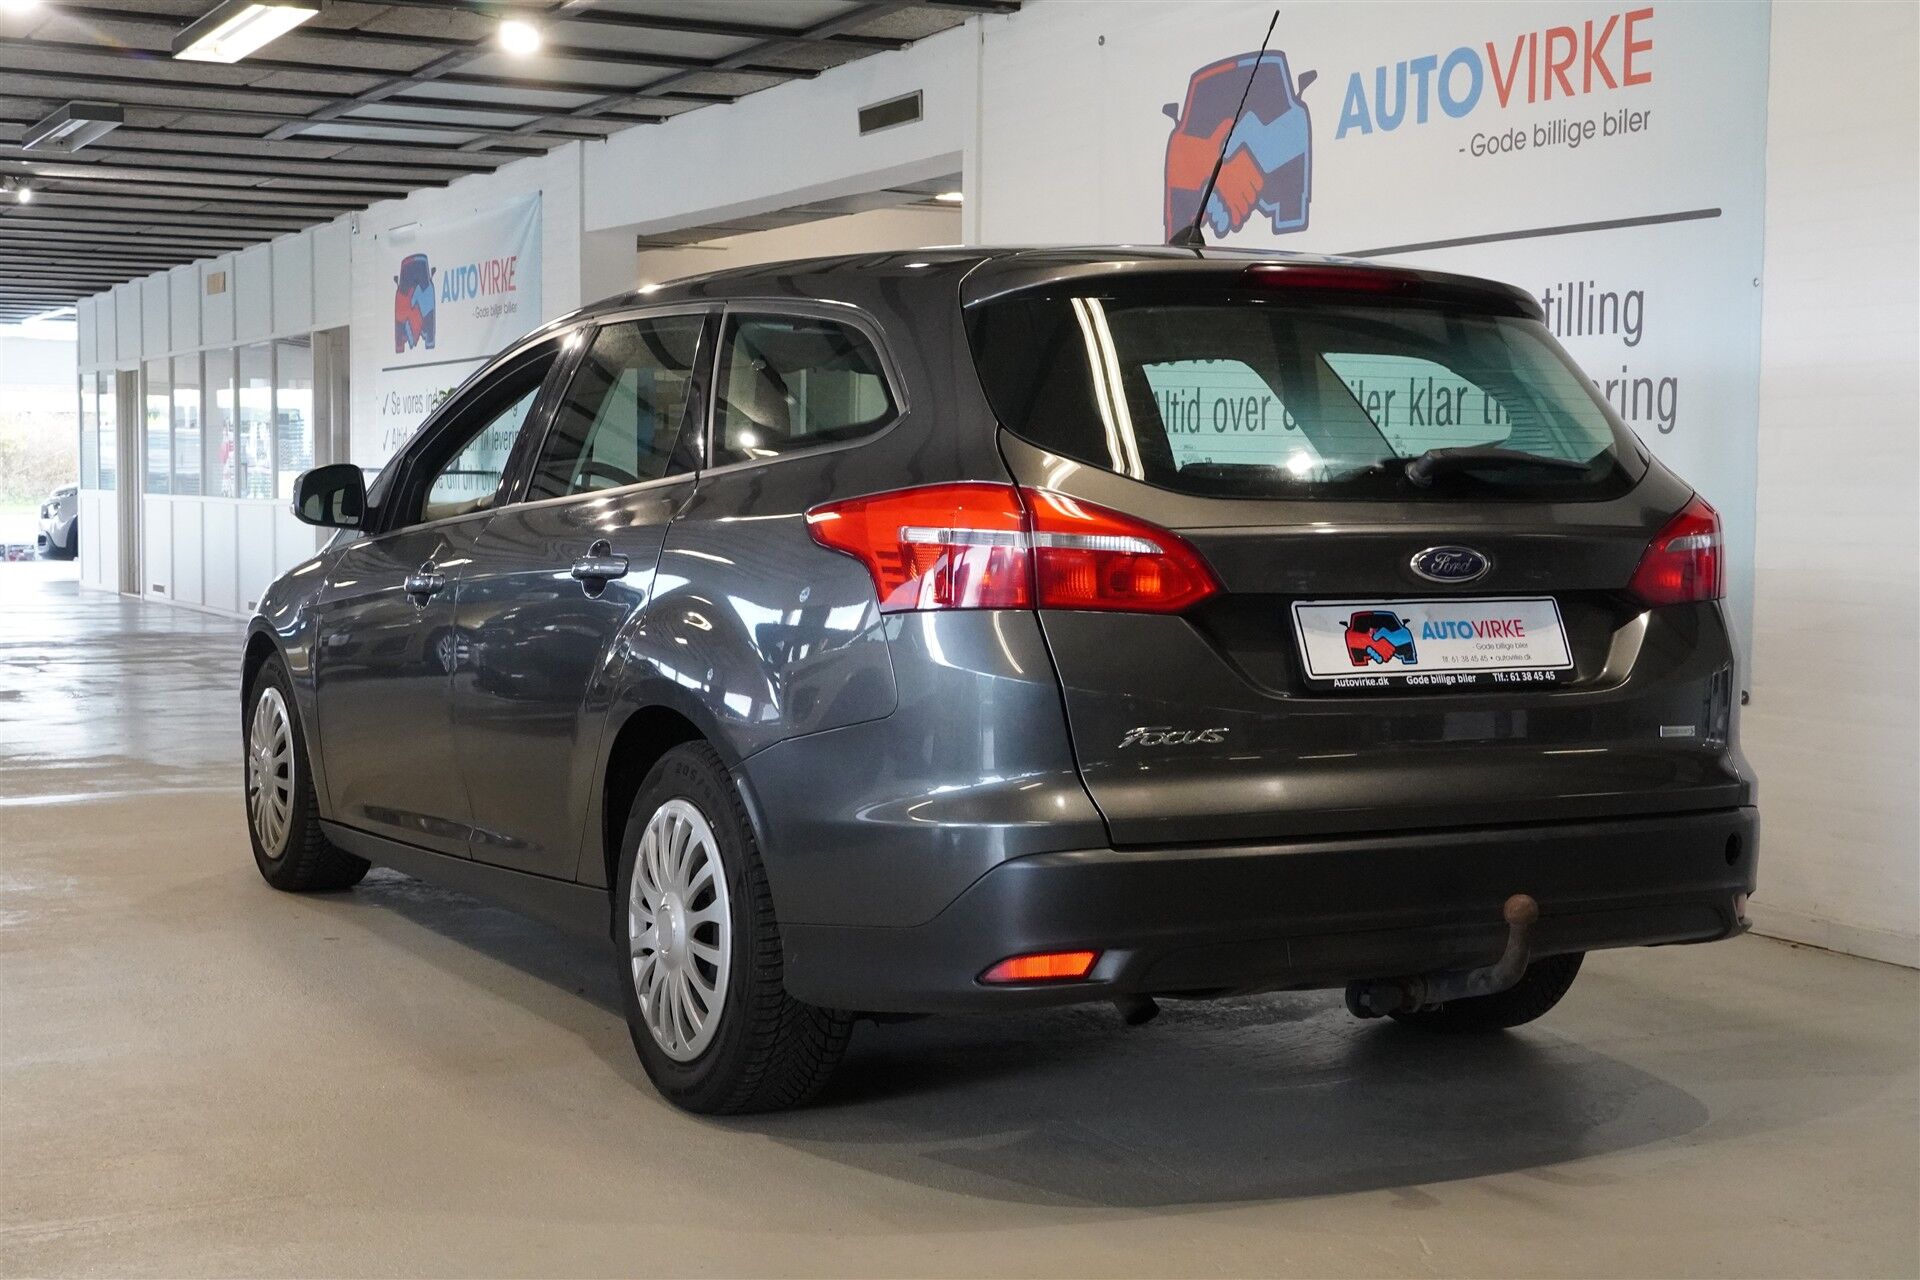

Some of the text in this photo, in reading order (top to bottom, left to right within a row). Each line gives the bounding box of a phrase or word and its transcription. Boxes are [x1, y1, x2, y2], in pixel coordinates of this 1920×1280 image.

[1335, 7, 1654, 140] AUTOVIRKE
[1470, 128, 1527, 157] Gode
[1533, 118, 1597, 149] billige
[1603, 108, 1652, 136] biler
[441, 256, 517, 303] AUTOVIRKE
[403, 394, 424, 415] vores
[1213, 395, 1272, 433] over
[1409, 376, 1469, 427] klar
[1430, 552, 1473, 575] Ford
[1422, 619, 1526, 640] AUTOVIRKE
[1333, 677, 1390, 688] Autovirke.dk
[1406, 675, 1428, 685] Gode
[1431, 673, 1457, 686] billige
[1458, 673, 1477, 683] biler
[1510, 672, 1521, 681] 61
[1522, 672, 1532, 681] 38
[1533, 671, 1544, 681] 45
[1545, 670, 1556, 680] 45
